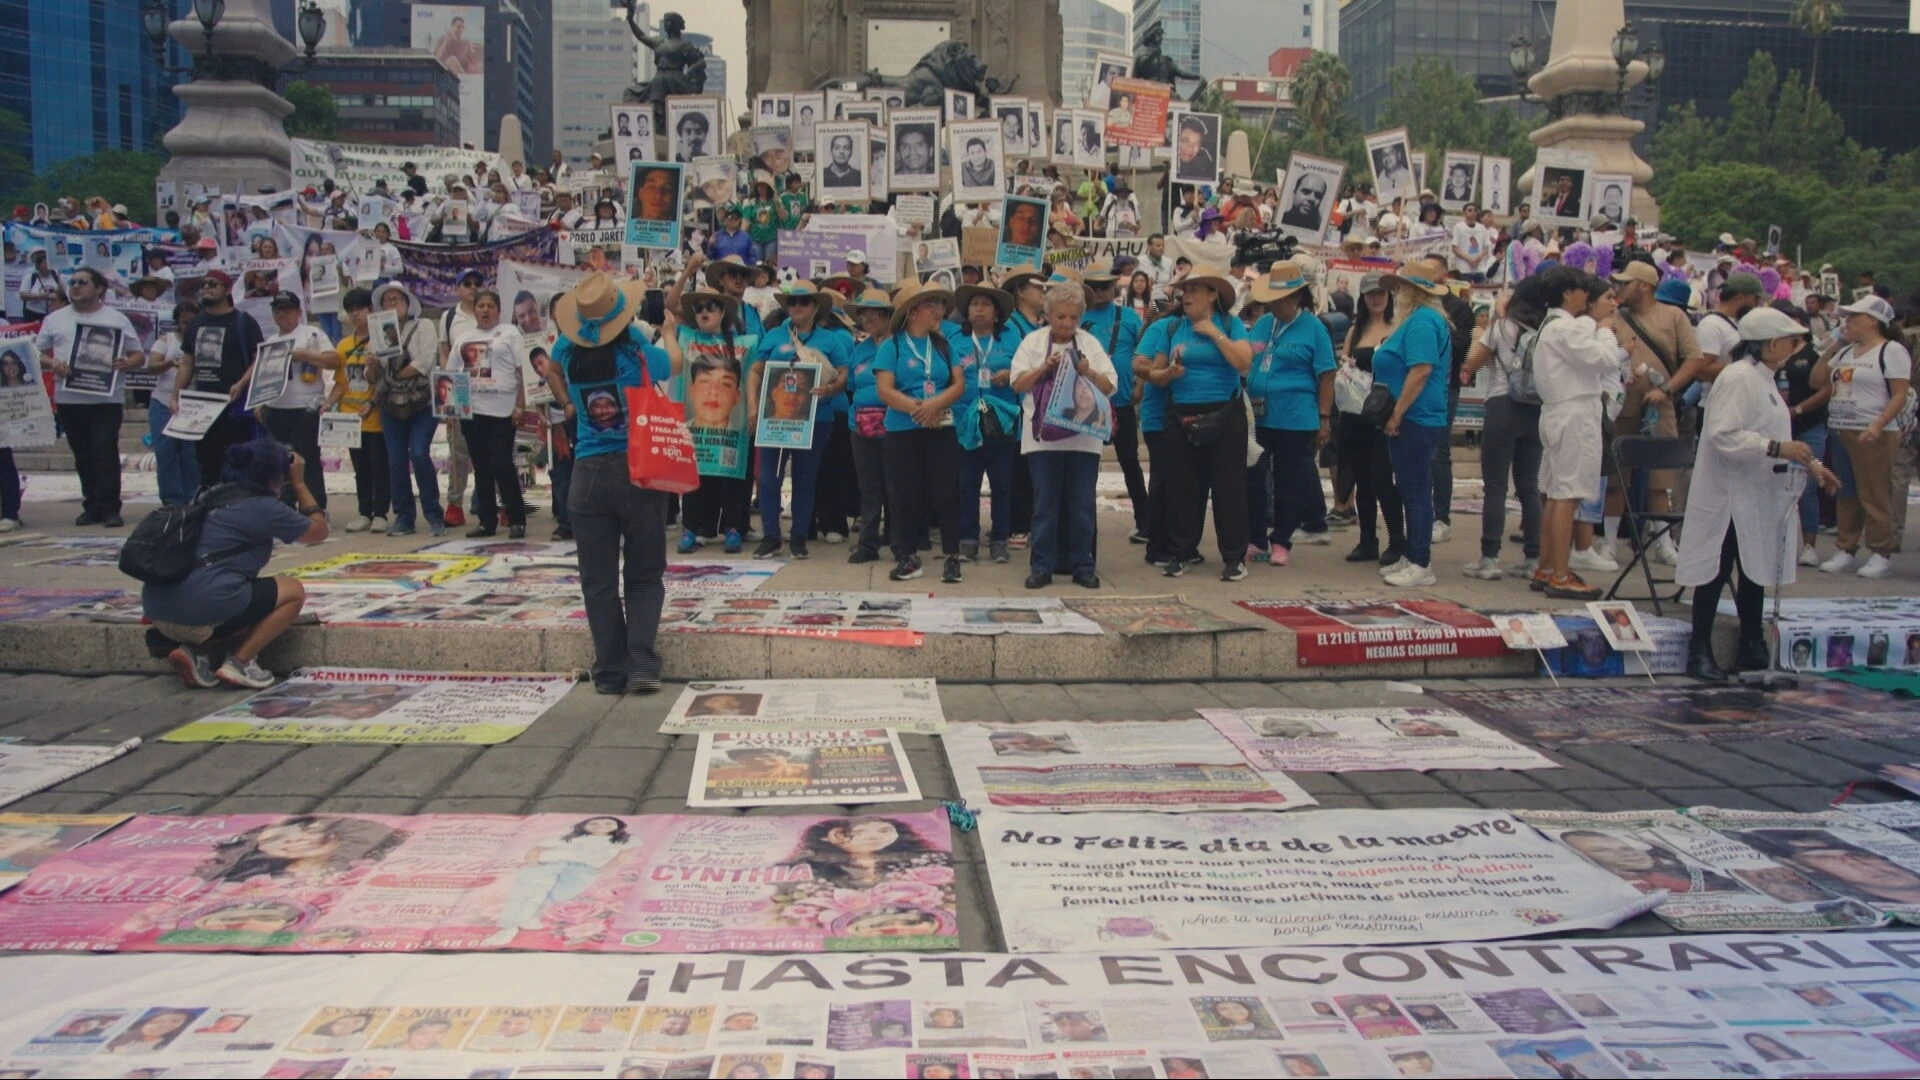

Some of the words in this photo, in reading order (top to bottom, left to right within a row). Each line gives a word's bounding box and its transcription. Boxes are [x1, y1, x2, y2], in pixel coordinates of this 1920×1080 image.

[569, 231, 596, 244] PABLO
[1317, 632, 1330, 646] EL
[1331, 631, 1343, 645] 21
[1344, 631, 1358, 644] DE
[1359, 629, 1394, 643] MARZO
[1396, 629, 1415, 642] DEL
[1415, 628, 1442, 640] 2009
[1444, 628, 1457, 639] EN
[1366, 645, 1406, 660] NEGRAS
[1408, 642, 1458, 656] COAHUILA
[1000, 829, 1063, 847] No
[1281, 838, 1333, 853] de
[1337, 834, 1385, 850] la
[1387, 818, 1517, 848] madre
[650, 864, 814, 883] CYNTHIA
[1085, 859, 1137, 871] mayo
[1139, 857, 1169, 867] NO
[1129, 869, 1202, 881] implica
[1336, 864, 1428, 878] exigencia
[1430, 862, 1454, 872] de
[1127, 880, 1202, 892] madres
[1333, 877, 1406, 891] madres
[1408, 875, 1444, 886] con
[1532, 873, 1556, 883] de
[1061, 894, 1180, 908] feminicidio
[1199, 894, 1276, 905] madres
[1369, 892, 1395, 903] de
[1397, 887, 1489, 900] violencia
[1233, 913, 1251, 923] la
[627, 956, 1069, 1001] ¡HASTA
